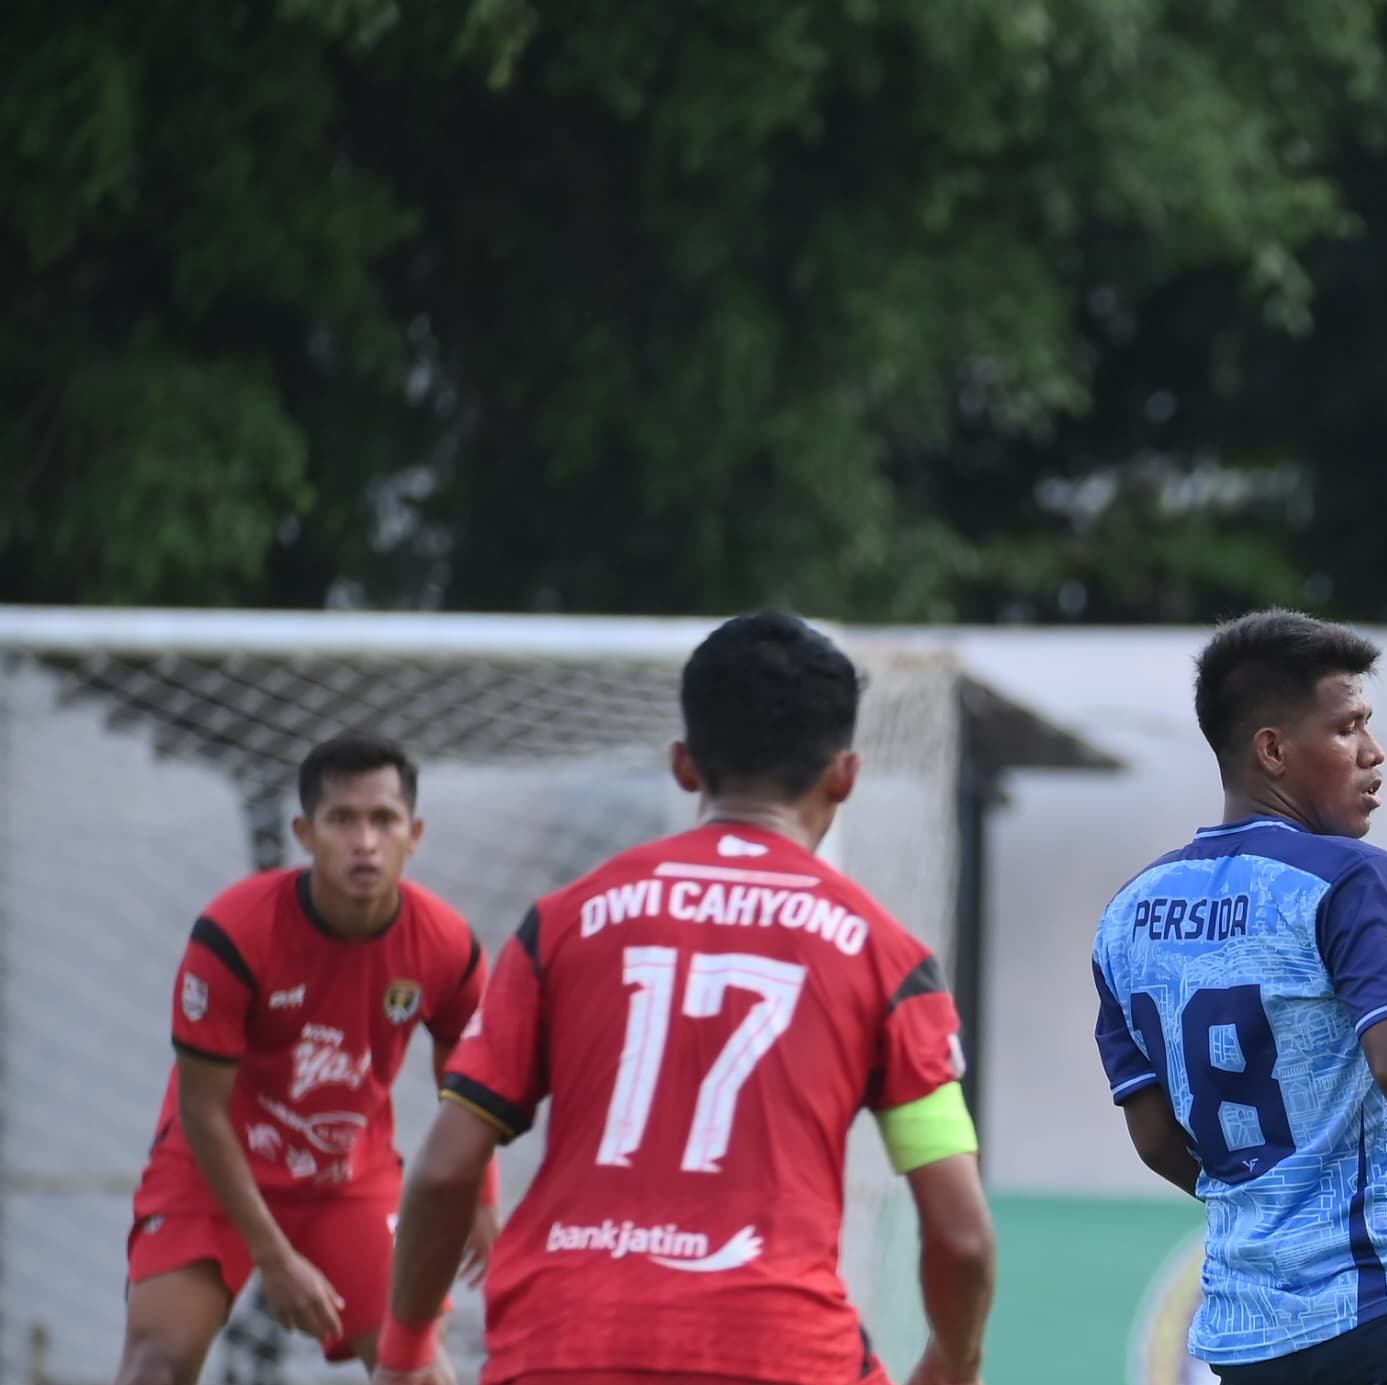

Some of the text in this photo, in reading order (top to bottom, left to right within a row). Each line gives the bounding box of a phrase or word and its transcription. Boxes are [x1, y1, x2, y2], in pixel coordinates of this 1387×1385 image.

[580, 879, 869, 956] DWI CAHYONO
[1132, 895, 1249, 943] PERSIDA
[596, 946, 808, 1174] 17
[546, 1218, 709, 1260] bankjatim
